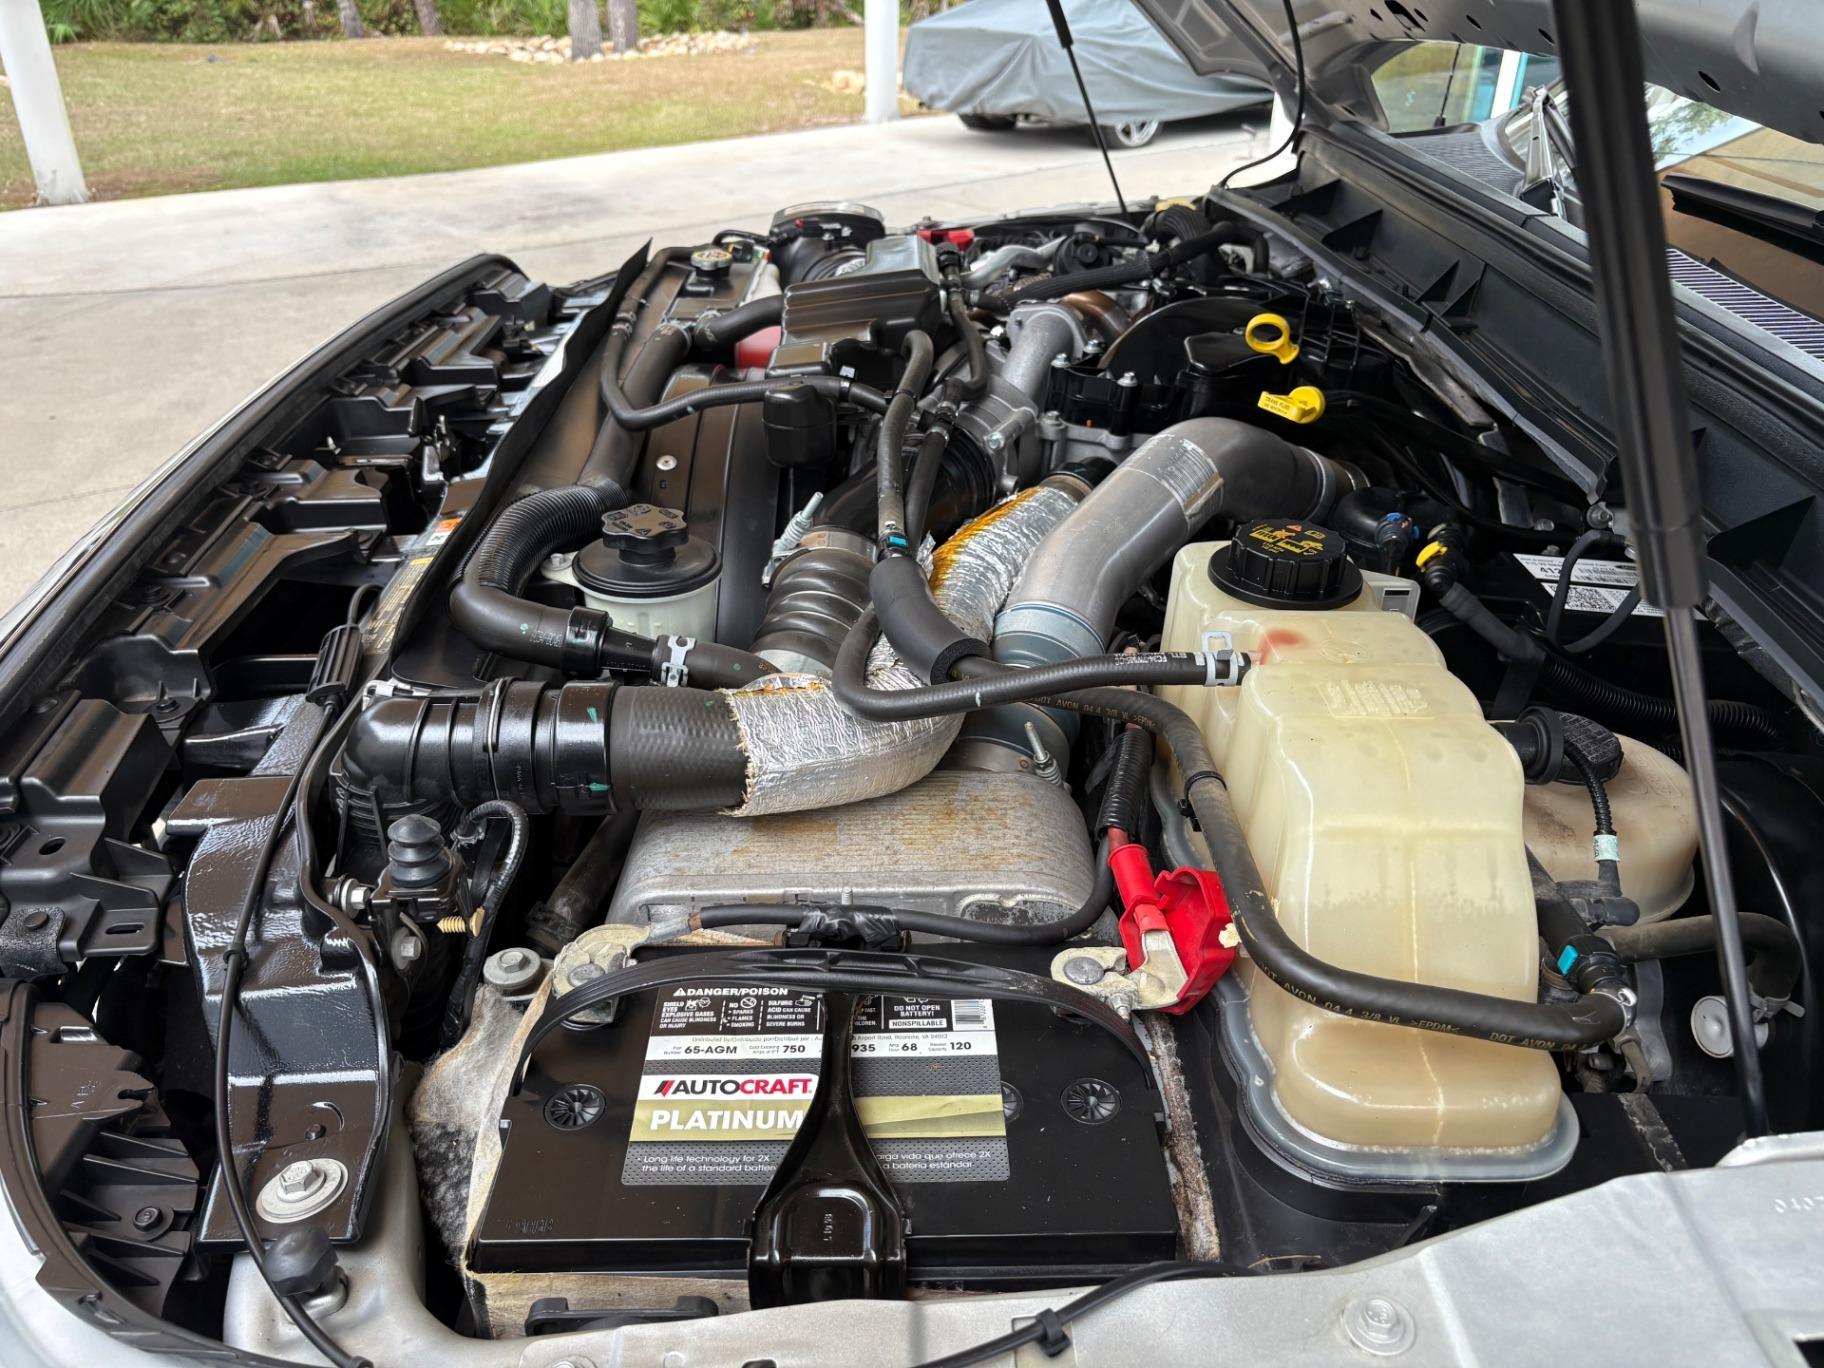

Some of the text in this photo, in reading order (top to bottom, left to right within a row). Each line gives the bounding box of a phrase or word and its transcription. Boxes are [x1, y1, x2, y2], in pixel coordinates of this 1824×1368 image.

[686, 987, 789, 997] DANGER/POISON
[1283, 982, 1317, 1003] AVON
[1489, 1031, 1517, 1043] DOT
[1520, 1038, 1556, 1049] AVON
[892, 1019, 944, 1027] NONSPILLABLE
[684, 1045, 738, 1055] 65-AGM
[783, 1044, 806, 1054] 750
[851, 1043, 876, 1053] 935
[901, 1042, 918, 1052] 68
[950, 1041, 972, 1051] 120
[671, 1078, 813, 1095] AUTOCRAFT
[650, 1109, 804, 1131] PLATINUM
[644, 1155, 668, 1165] Long
[686, 1155, 741, 1164] technology
[743, 1154, 756, 1162] for
[758, 1154, 770, 1162] 2X
[876, 1150, 991, 1162] arga vida que ofrece 2X
[642, 1164, 659, 1172] the
[660, 1164, 674, 1172] life
[676, 1164, 687, 1172] of
[698, 1164, 742, 1172] standard
